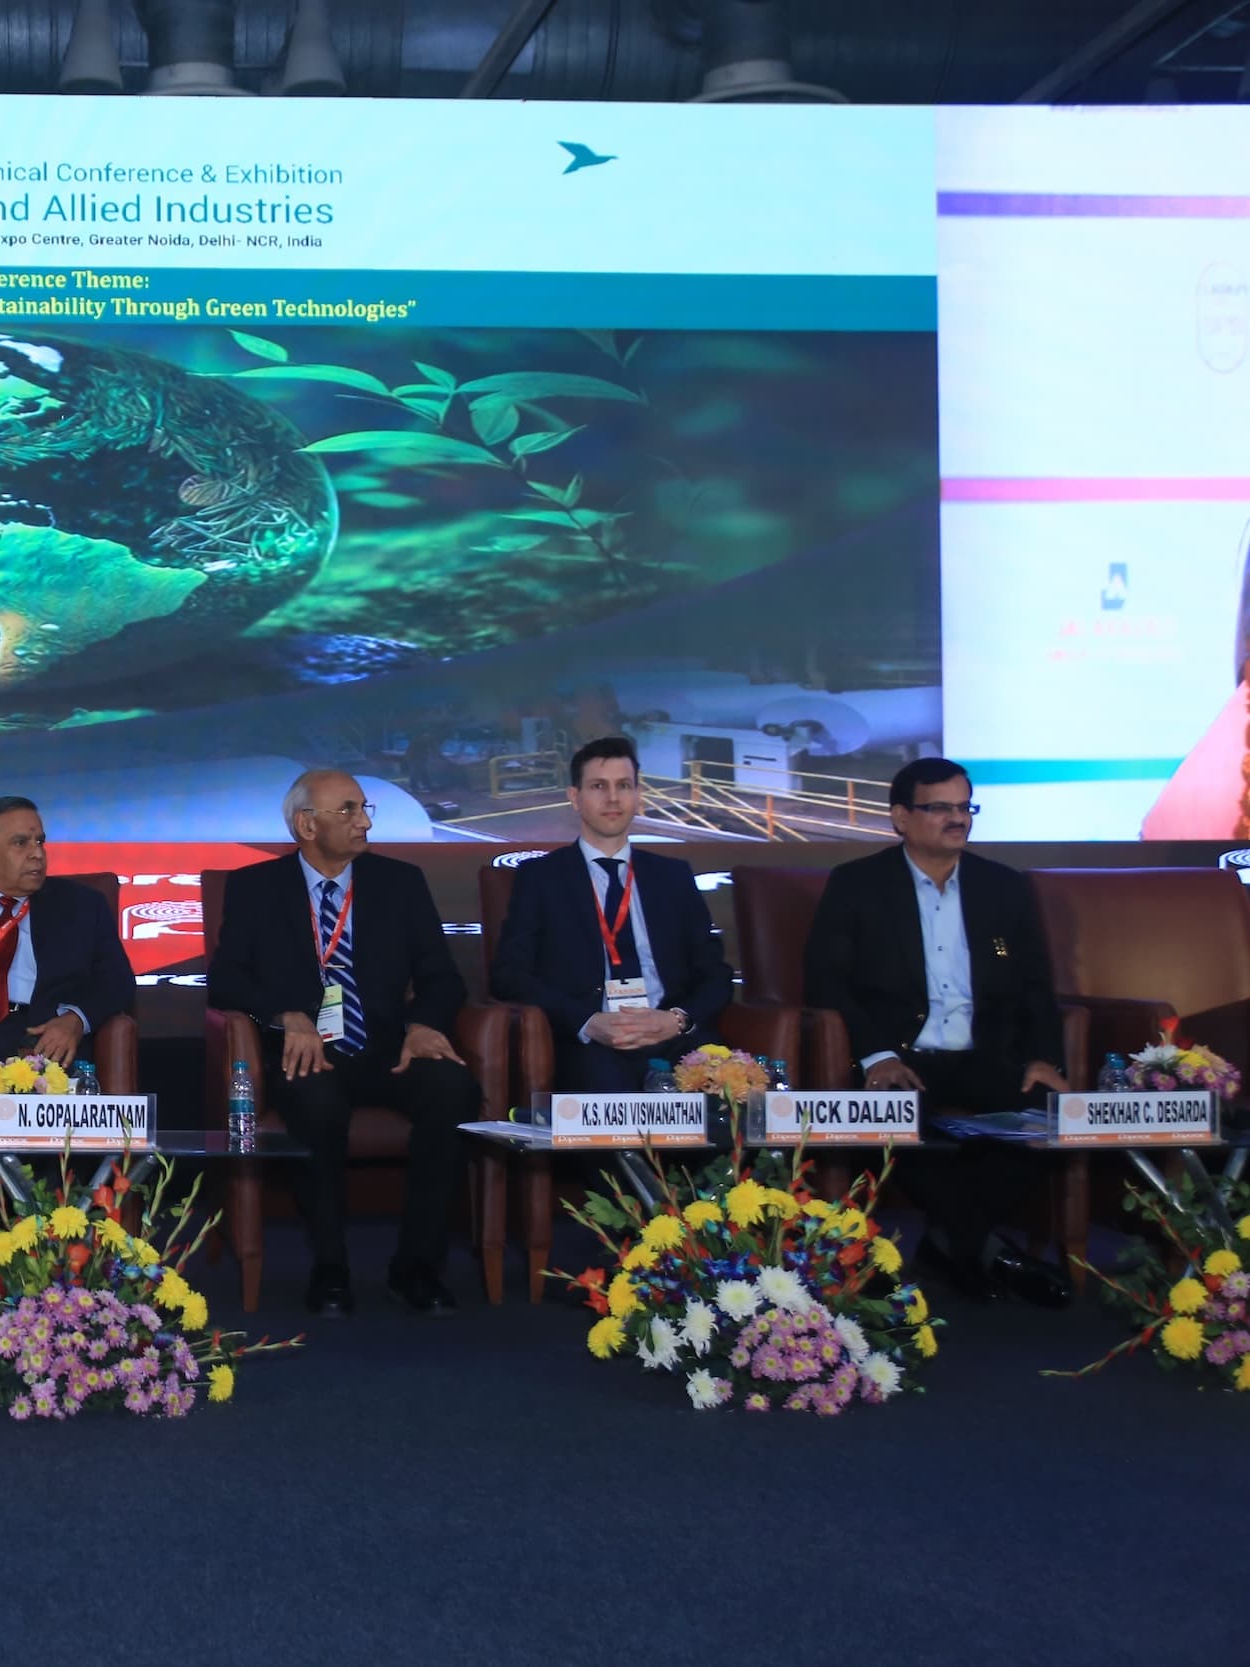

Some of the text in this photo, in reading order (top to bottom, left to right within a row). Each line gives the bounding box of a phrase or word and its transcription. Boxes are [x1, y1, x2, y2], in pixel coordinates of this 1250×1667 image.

[57, 162, 194, 184] Conference
[200, 163, 217, 184] &
[226, 163, 343, 185] Exhibition
[43, 193, 141, 223] Allied
[156, 194, 334, 224] Industries
[31, 233, 84, 247] Centre,
[89, 234, 142, 246] Greater
[148, 234, 194, 249] Noida,
[247, 234, 282, 249] NCR,
[287, 234, 323, 248] India
[72, 270, 149, 289] Theme:
[110, 297, 200, 320] Through
[206, 298, 268, 318] Green
[18, 1103, 145, 1129] N. GOPALARATNAM
[581, 1101, 702, 1126] K.S. KASI VISWANATHAN
[795, 1100, 915, 1124] NICK DALAIS
[1087, 1100, 1207, 1125] SHEKHAR C. DESARDA
